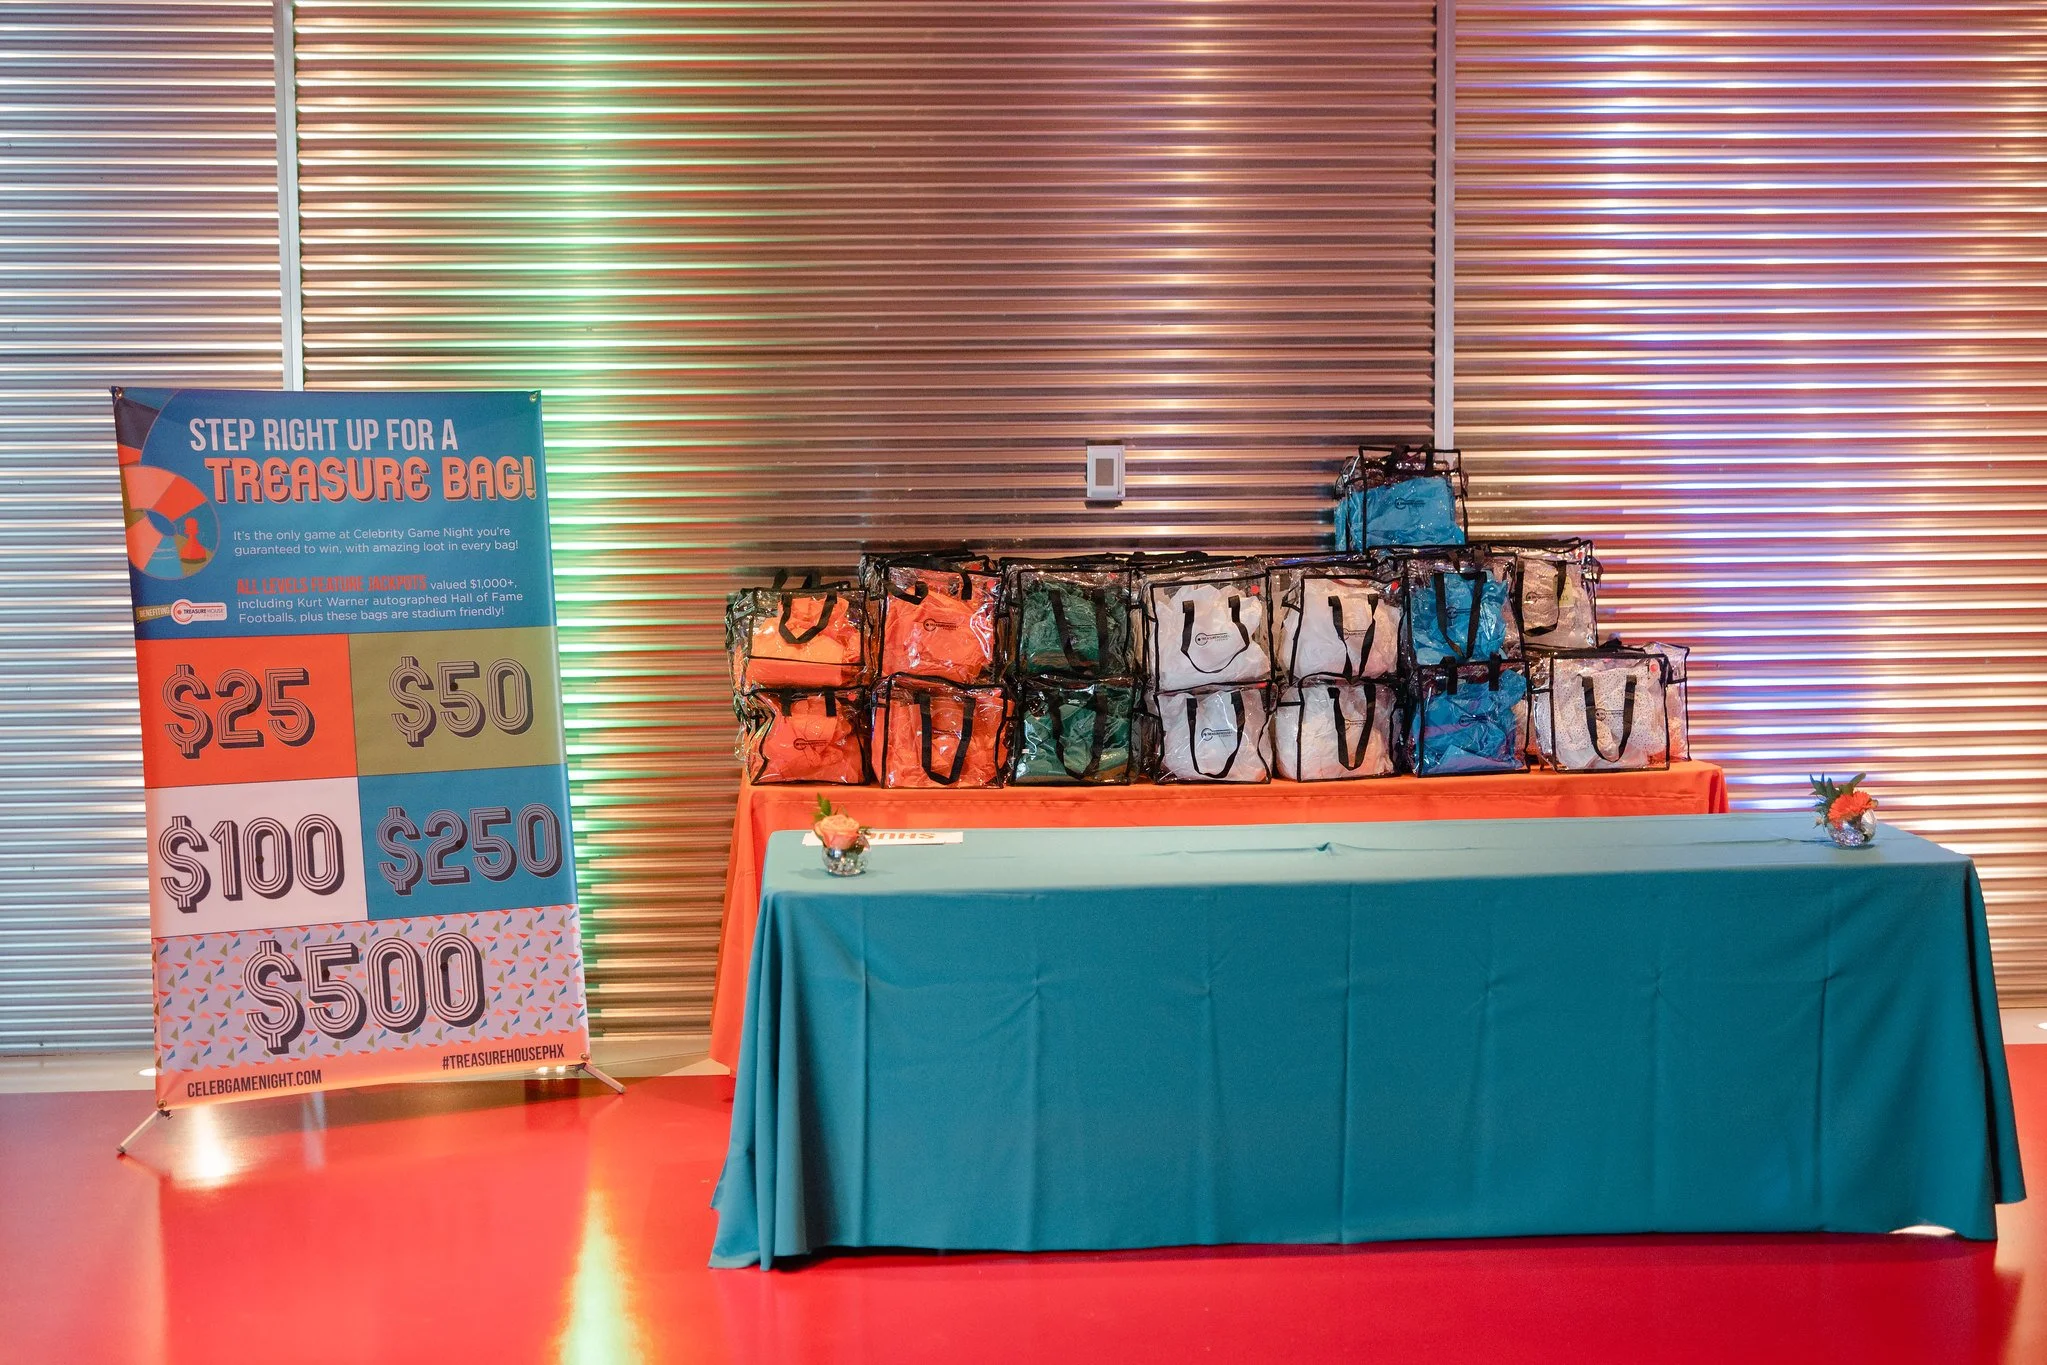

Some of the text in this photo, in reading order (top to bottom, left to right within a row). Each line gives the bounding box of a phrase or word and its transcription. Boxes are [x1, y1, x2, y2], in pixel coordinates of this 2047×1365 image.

[189, 417, 459, 451] STEP RIGHT UP FOR A
[203, 455, 537, 504] TREASURE BAG!
[233, 527, 510, 542] It's the only game at Celebrity Game Night you're
[234, 540, 519, 557] guaranteed to win, with amazing loot in every bag!
[236, 574, 517, 595] ALL LEVELS FEATURE JACKPOTS valued $1,000+,
[139, 607, 170, 618] BENEFITING
[238, 592, 523, 610] including Kurt Warner autographed Hall of Fame
[239, 606, 505, 624] Footballs, plus these bags are stadium friendly!
[161, 664, 316, 760] $25
[388, 656, 534, 748] $50
[158, 815, 346, 914] $100
[376, 803, 565, 897] $250
[243, 932, 486, 1055] $500
[441, 1043, 566, 1071] #TREASUREHOUSEPHX
[187, 1069, 323, 1099] CELEBGAMENIGHT.COM
